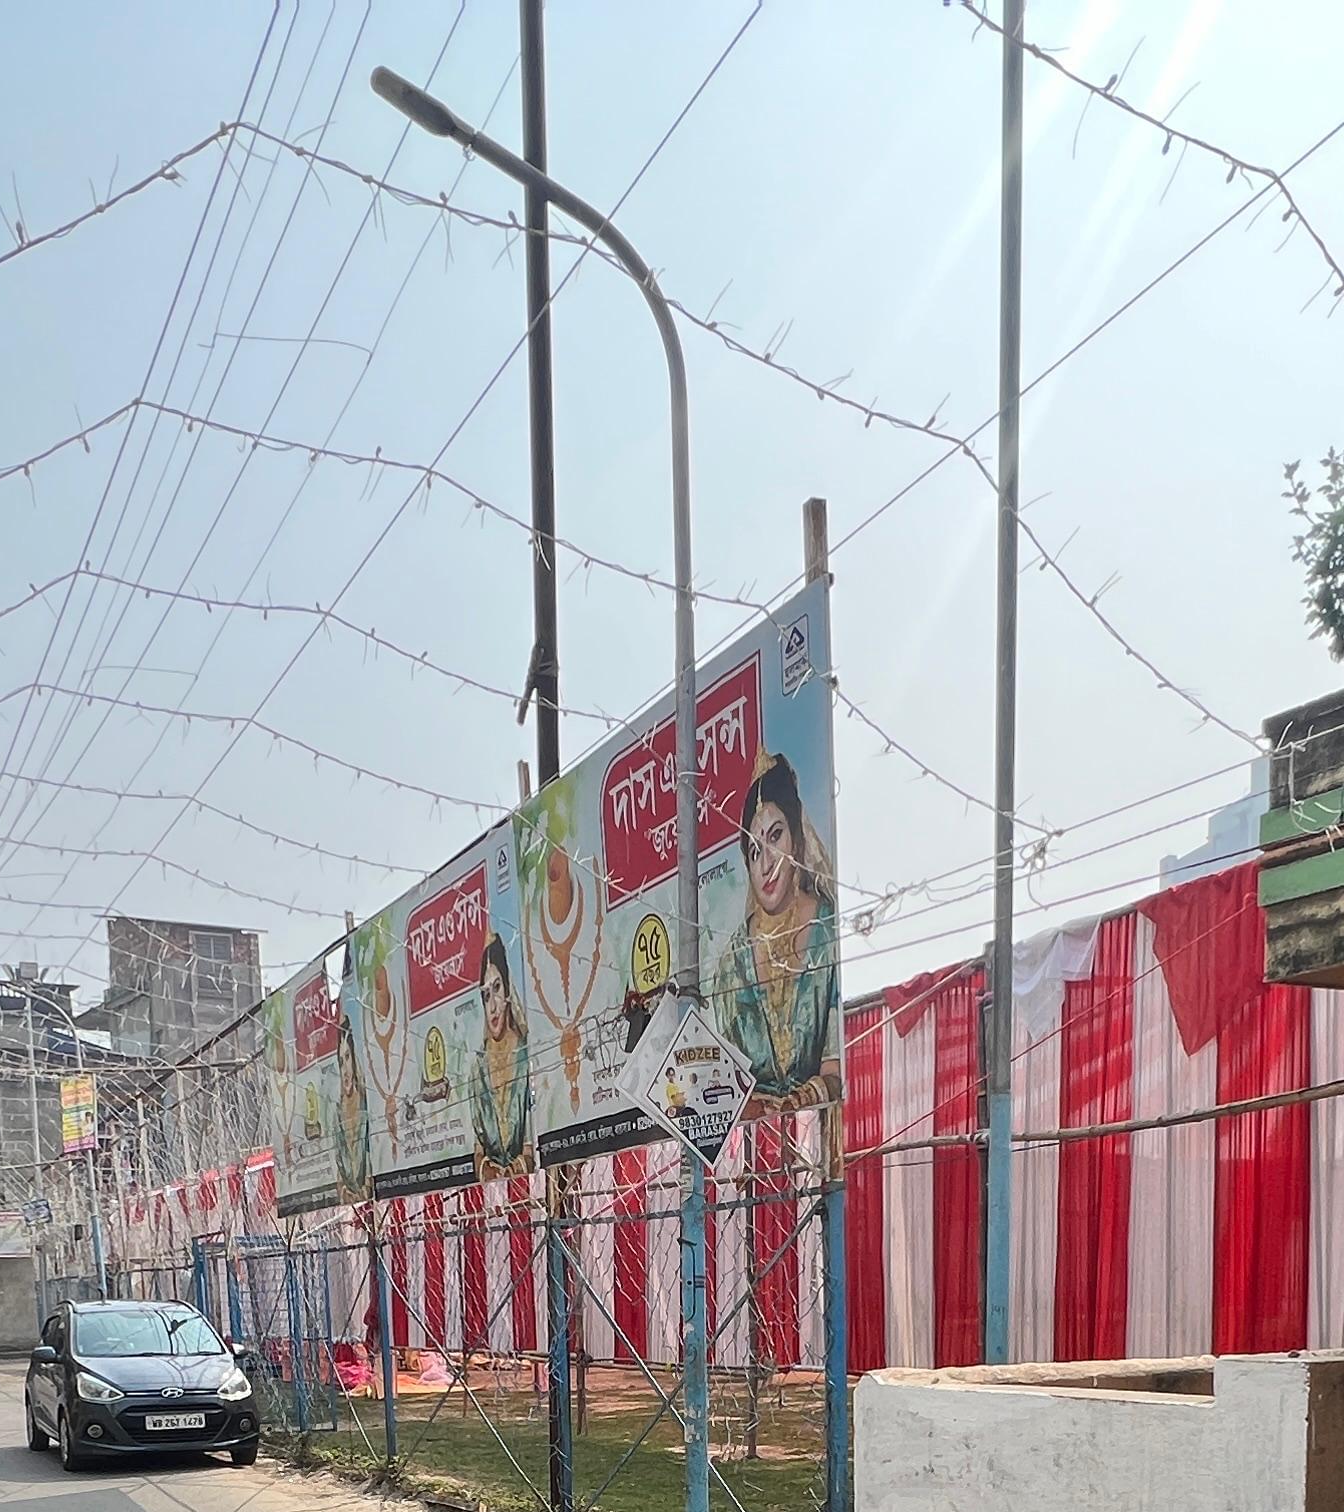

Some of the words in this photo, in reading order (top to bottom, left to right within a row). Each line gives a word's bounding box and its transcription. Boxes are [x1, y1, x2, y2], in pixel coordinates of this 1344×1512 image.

[609, 760, 657, 834] দাস
[674, 1046, 721, 1067] KIDZEE
[688, 1123, 729, 1140] BARASAT
